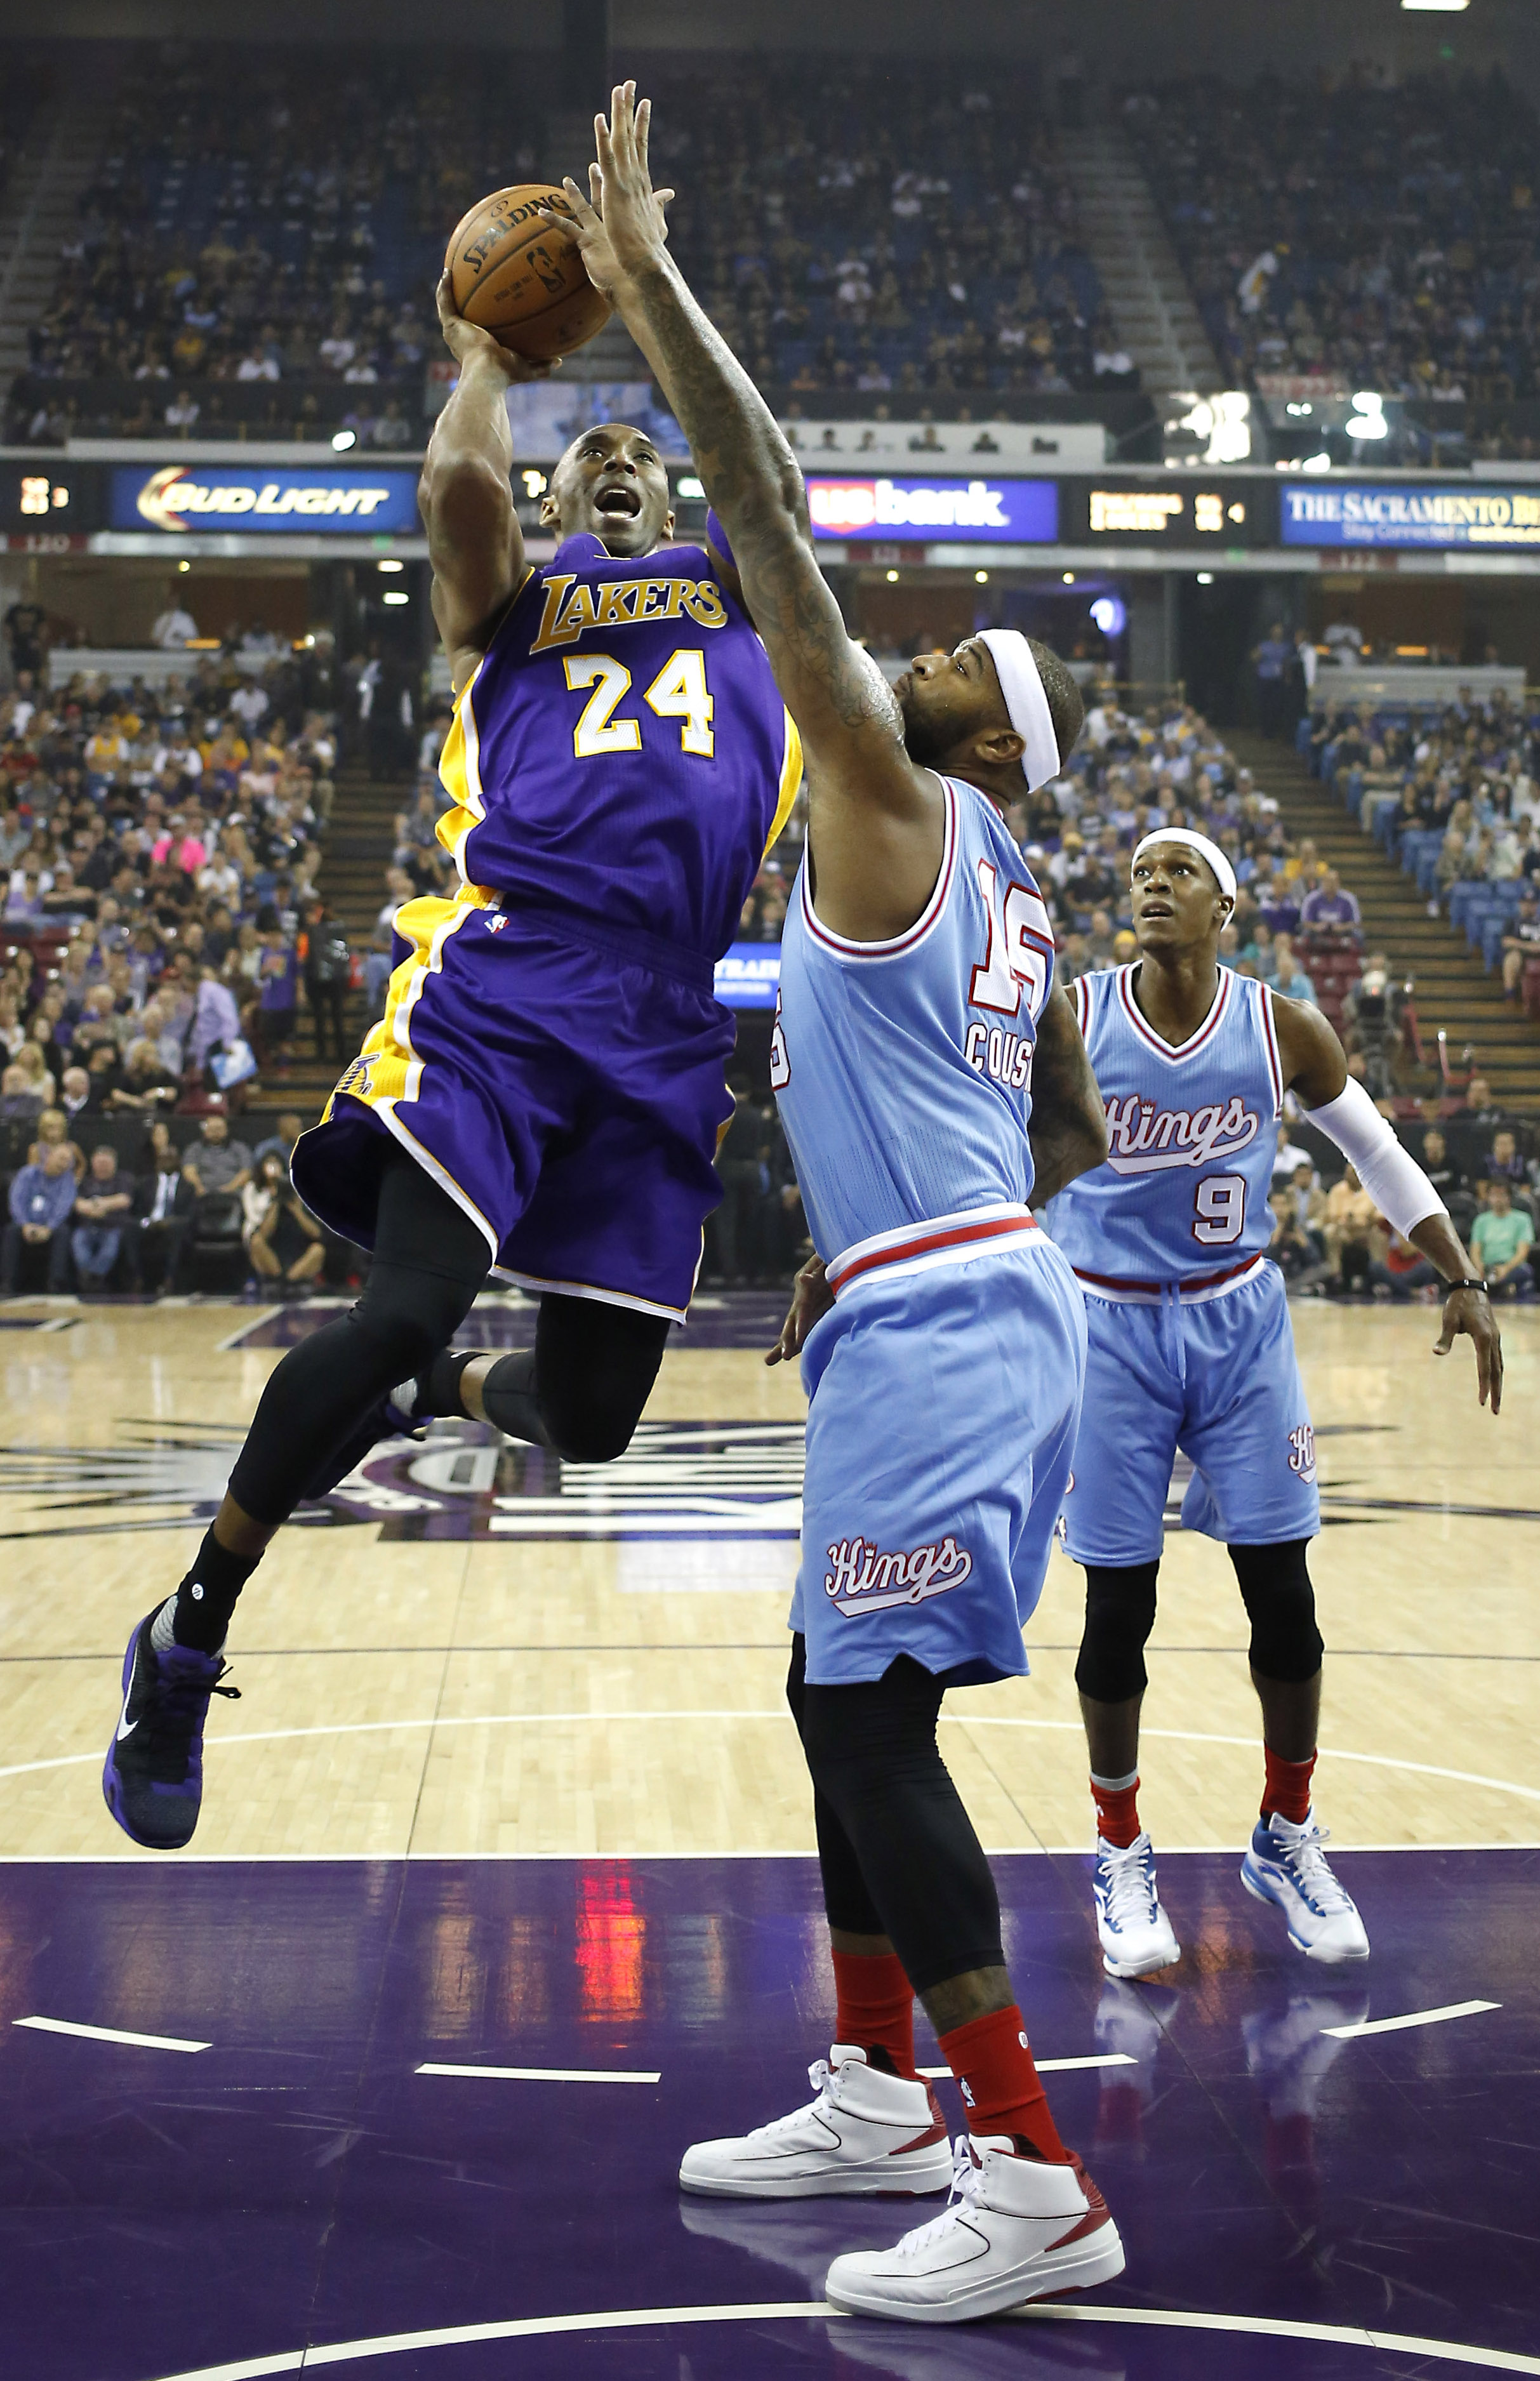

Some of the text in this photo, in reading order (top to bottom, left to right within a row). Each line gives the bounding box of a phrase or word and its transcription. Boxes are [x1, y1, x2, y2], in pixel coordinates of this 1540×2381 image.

[463, 193, 571, 274] SPALDING
[255, 484, 390, 515] LIGHT
[1286, 491, 1340, 522] THE
[1341, 491, 1511, 526] SACRAMENTO
[529, 574, 728, 655] LAKERS
[562, 649, 714, 758] 24
[1106, 1095, 1259, 1175] Kings
[1193, 1175, 1246, 1245] 9
[825, 1536, 972, 1618] Kings
